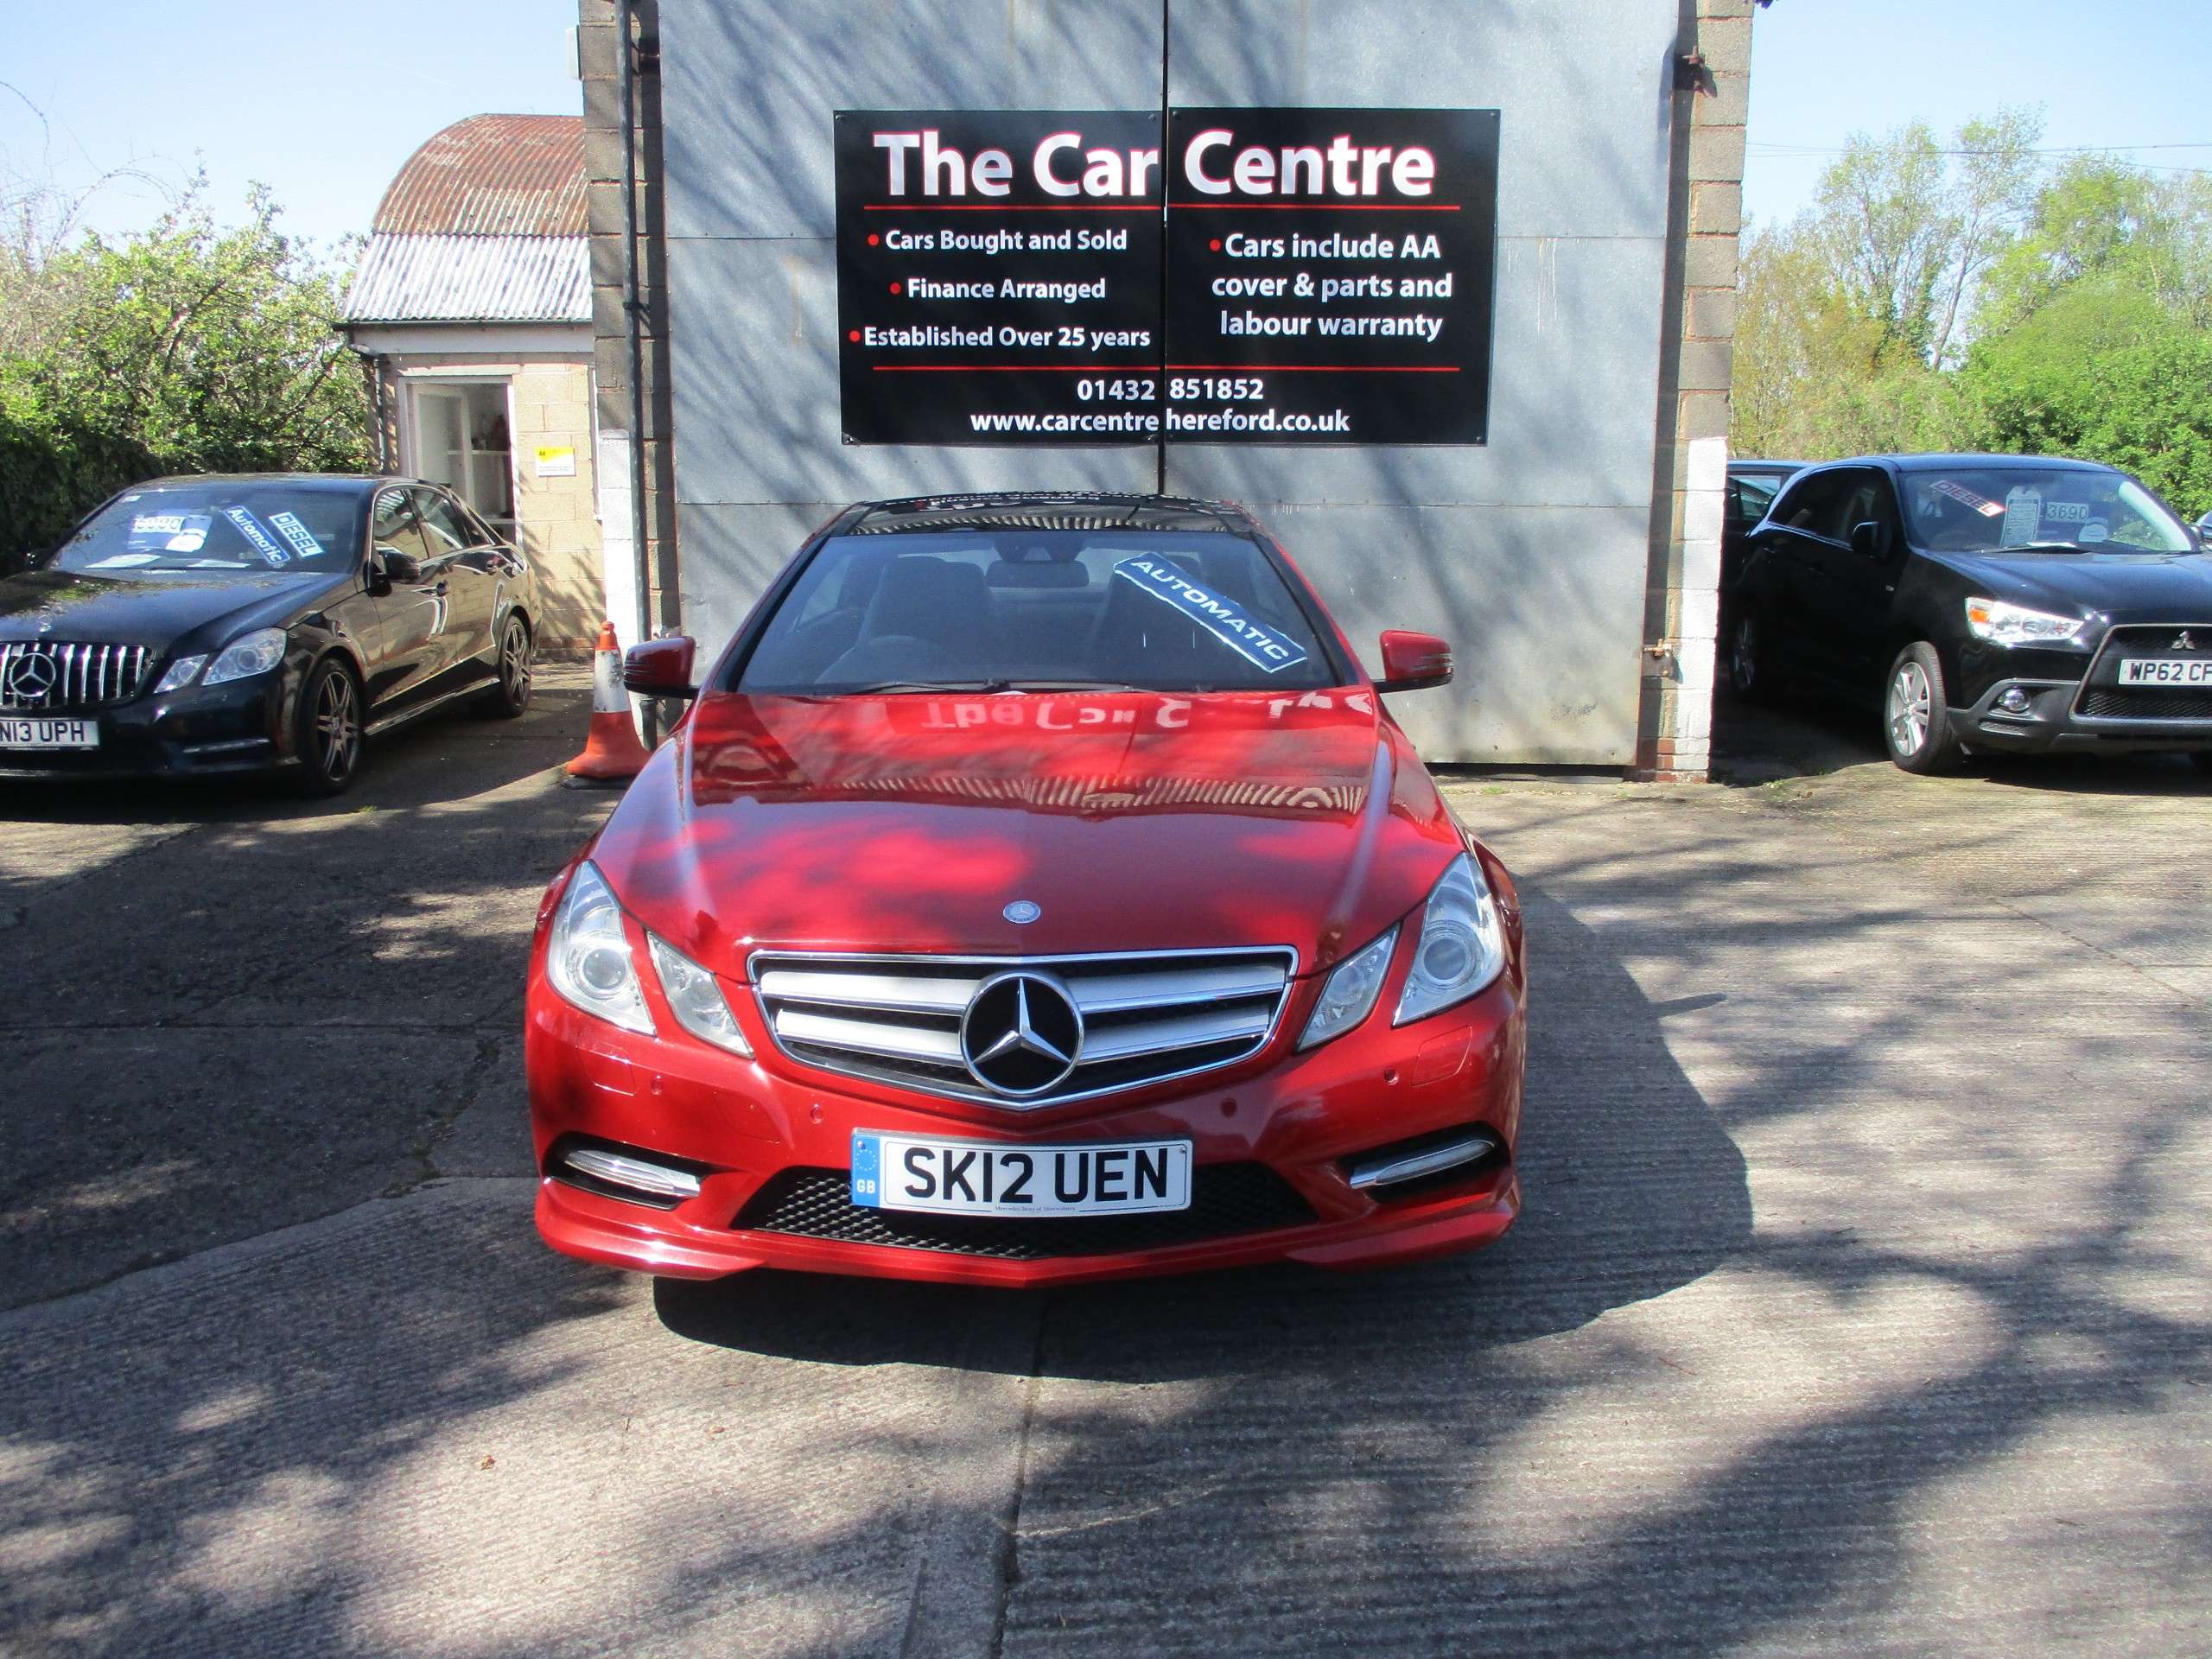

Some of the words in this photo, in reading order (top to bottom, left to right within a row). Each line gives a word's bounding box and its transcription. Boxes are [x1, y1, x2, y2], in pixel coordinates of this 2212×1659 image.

[873, 129, 1013, 197] The
[1033, 130, 1160, 197] Car
[1184, 129, 1436, 197] Centre
[885, 229, 935, 251] Cars
[940, 229, 1024, 255] Bought
[1028, 229, 1071, 251] and
[1077, 228, 1128, 251] Sold
[1225, 232, 1286, 257] Cars
[1292, 232, 1395, 259] include
[1400, 234, 1441, 259] AA
[907, 277, 995, 299] Finance
[1000, 277, 1106, 304] Arranged
[1211, 276, 1288, 297] cover
[1293, 272, 1315, 297] &
[1321, 275, 1394, 303] parts
[1399, 271, 1453, 298] and
[864, 325, 993, 347] Established
[999, 327, 1053, 346] Over
[1058, 327, 1085, 346] 25
[1090, 330, 1151, 352] years
[1220, 310, 1312, 335] labour
[1317, 313, 1444, 343] warranty
[1077, 378, 1155, 402] 01432
[1169, 378, 1264, 401] 851852
[1936, 482, 1996, 514] DIESEL
[227, 508, 283, 563] Automatic
[276, 515, 318, 555] DIESEL
[1130, 561, 1290, 661] AUTOMATIC
[2129, 662, 2183, 681] WP62
[39, 722, 85, 742] UPH
[856, 1179, 875, 1194] GB
[903, 1147, 1034, 1205] SK12
[1054, 1147, 1168, 1204] UEN
